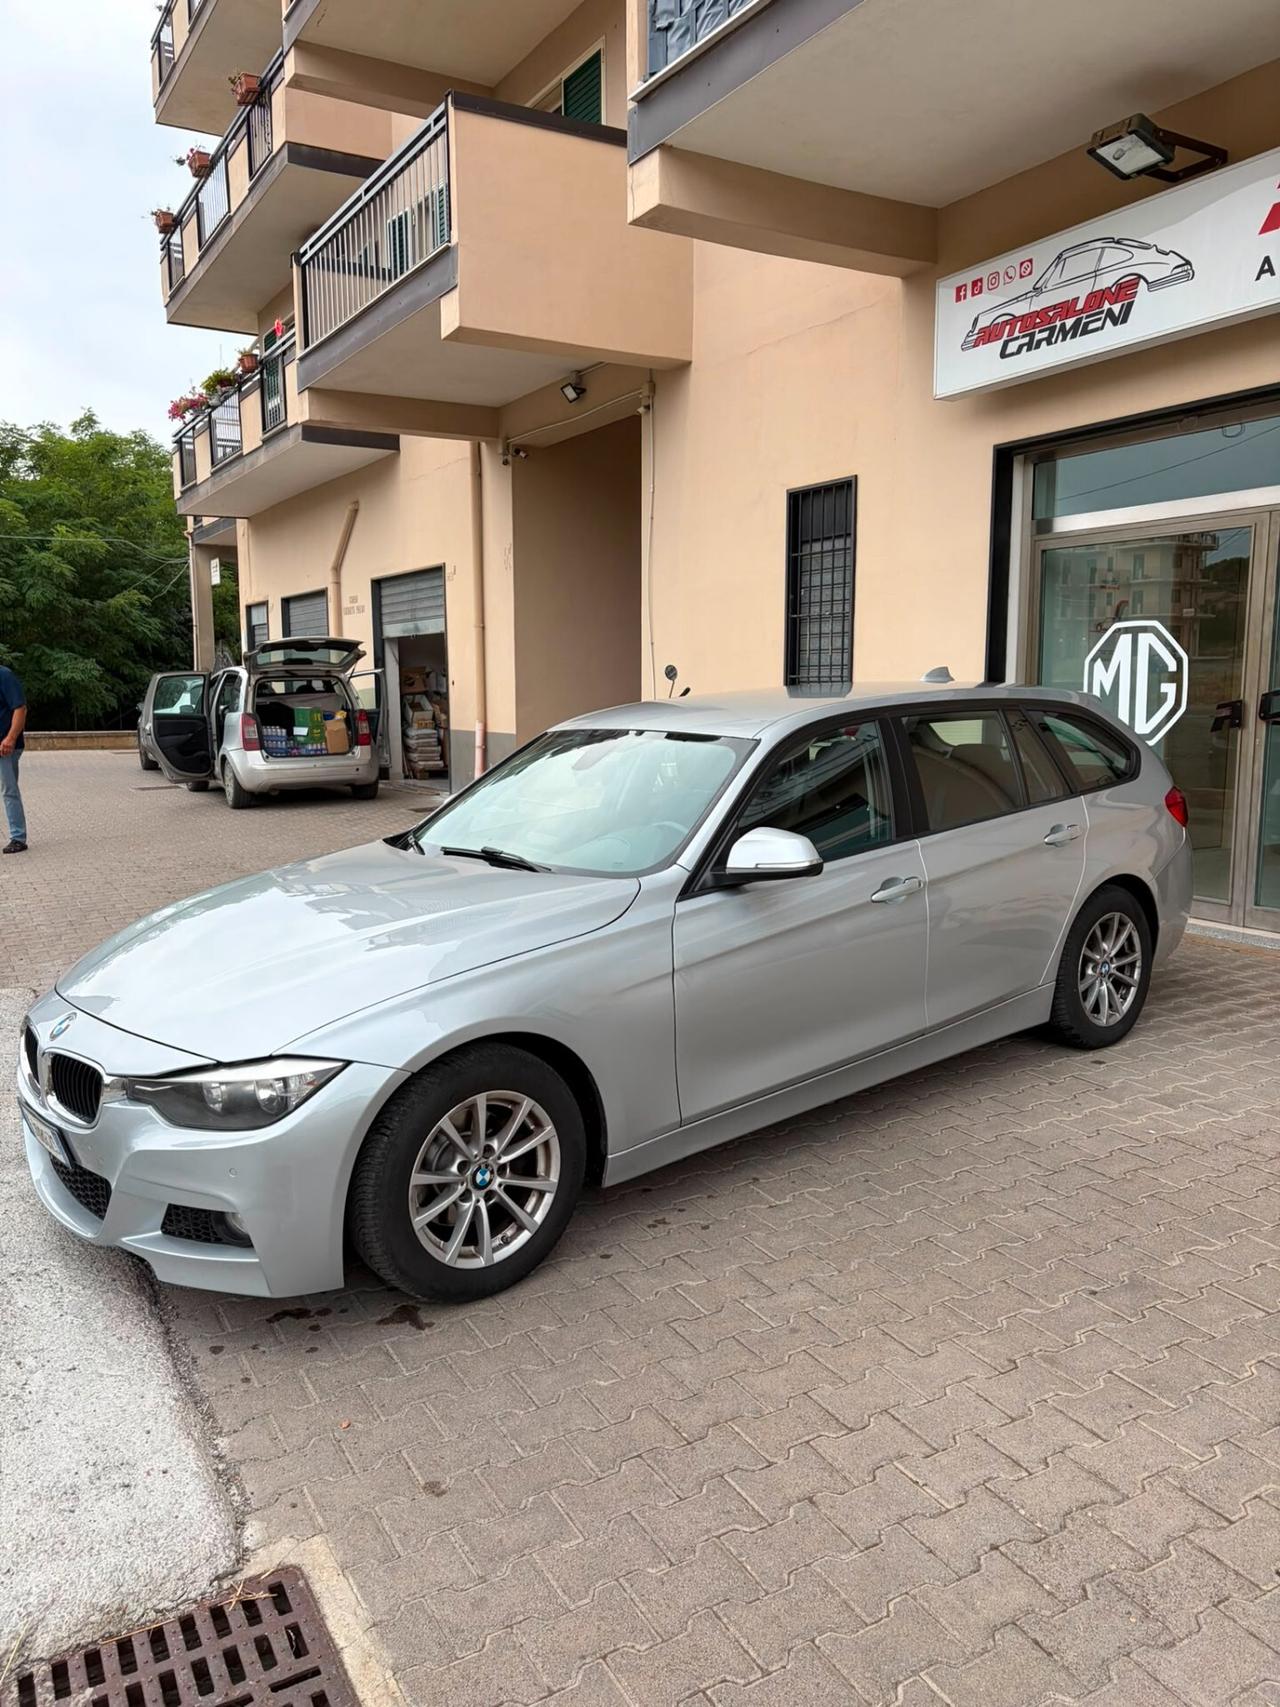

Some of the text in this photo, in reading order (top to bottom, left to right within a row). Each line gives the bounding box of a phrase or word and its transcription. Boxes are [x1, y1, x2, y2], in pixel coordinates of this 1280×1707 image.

[973, 276, 1141, 348] AUTOSALONE
[1000, 300, 1135, 359] CARMENI
[1093, 633, 1177, 734] MG
